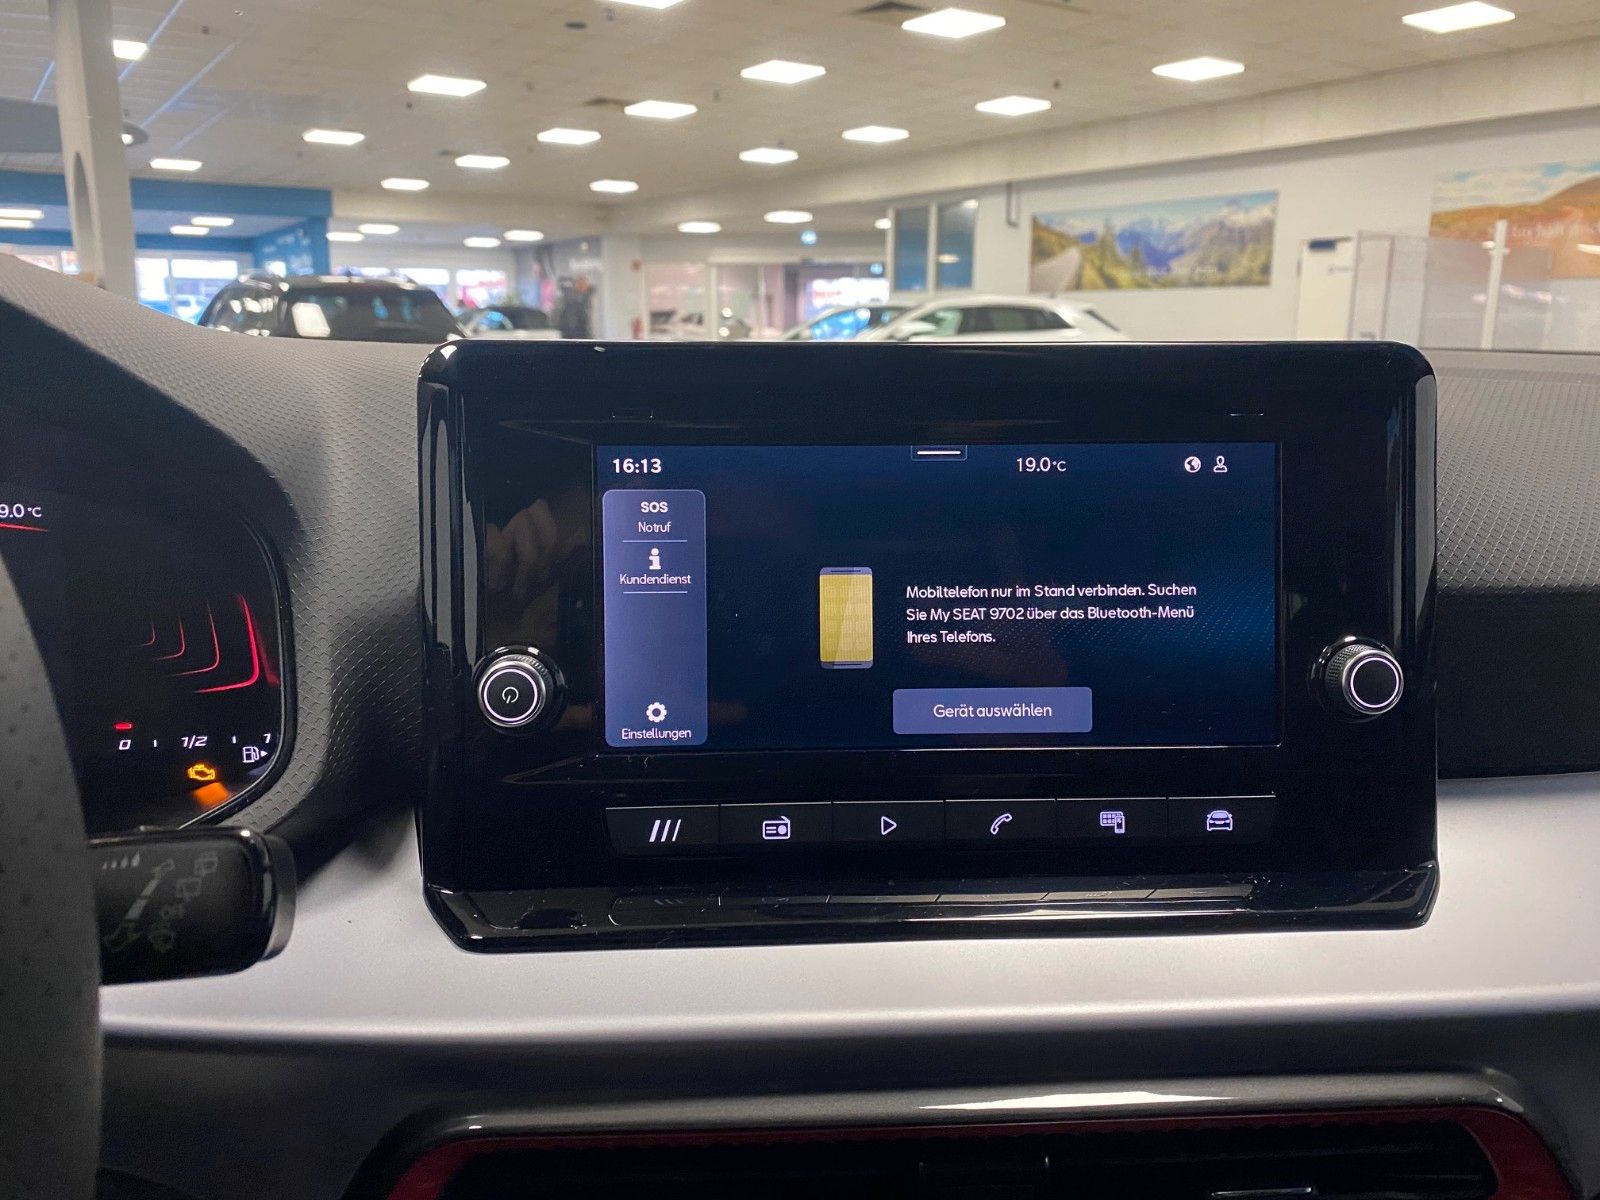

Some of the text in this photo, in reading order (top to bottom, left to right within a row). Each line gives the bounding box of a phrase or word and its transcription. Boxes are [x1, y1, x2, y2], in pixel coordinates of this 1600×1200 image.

[612, 457, 663, 474] 16:13
[640, 501, 669, 513] SOS
[638, 520, 672, 533] Notruf
[619, 573, 692, 585] Kundendienst
[906, 582, 1197, 599] Mobiltelefon nur im Stand verbinden. Suchen
[906, 605, 1195, 623] Sie My SEAT 9702 über das Bluetooth-Menü
[906, 630, 996, 644] Ihres Telefons.
[933, 702, 1053, 718] Gerät auswählen
[621, 727, 692, 741] Einstellungen
